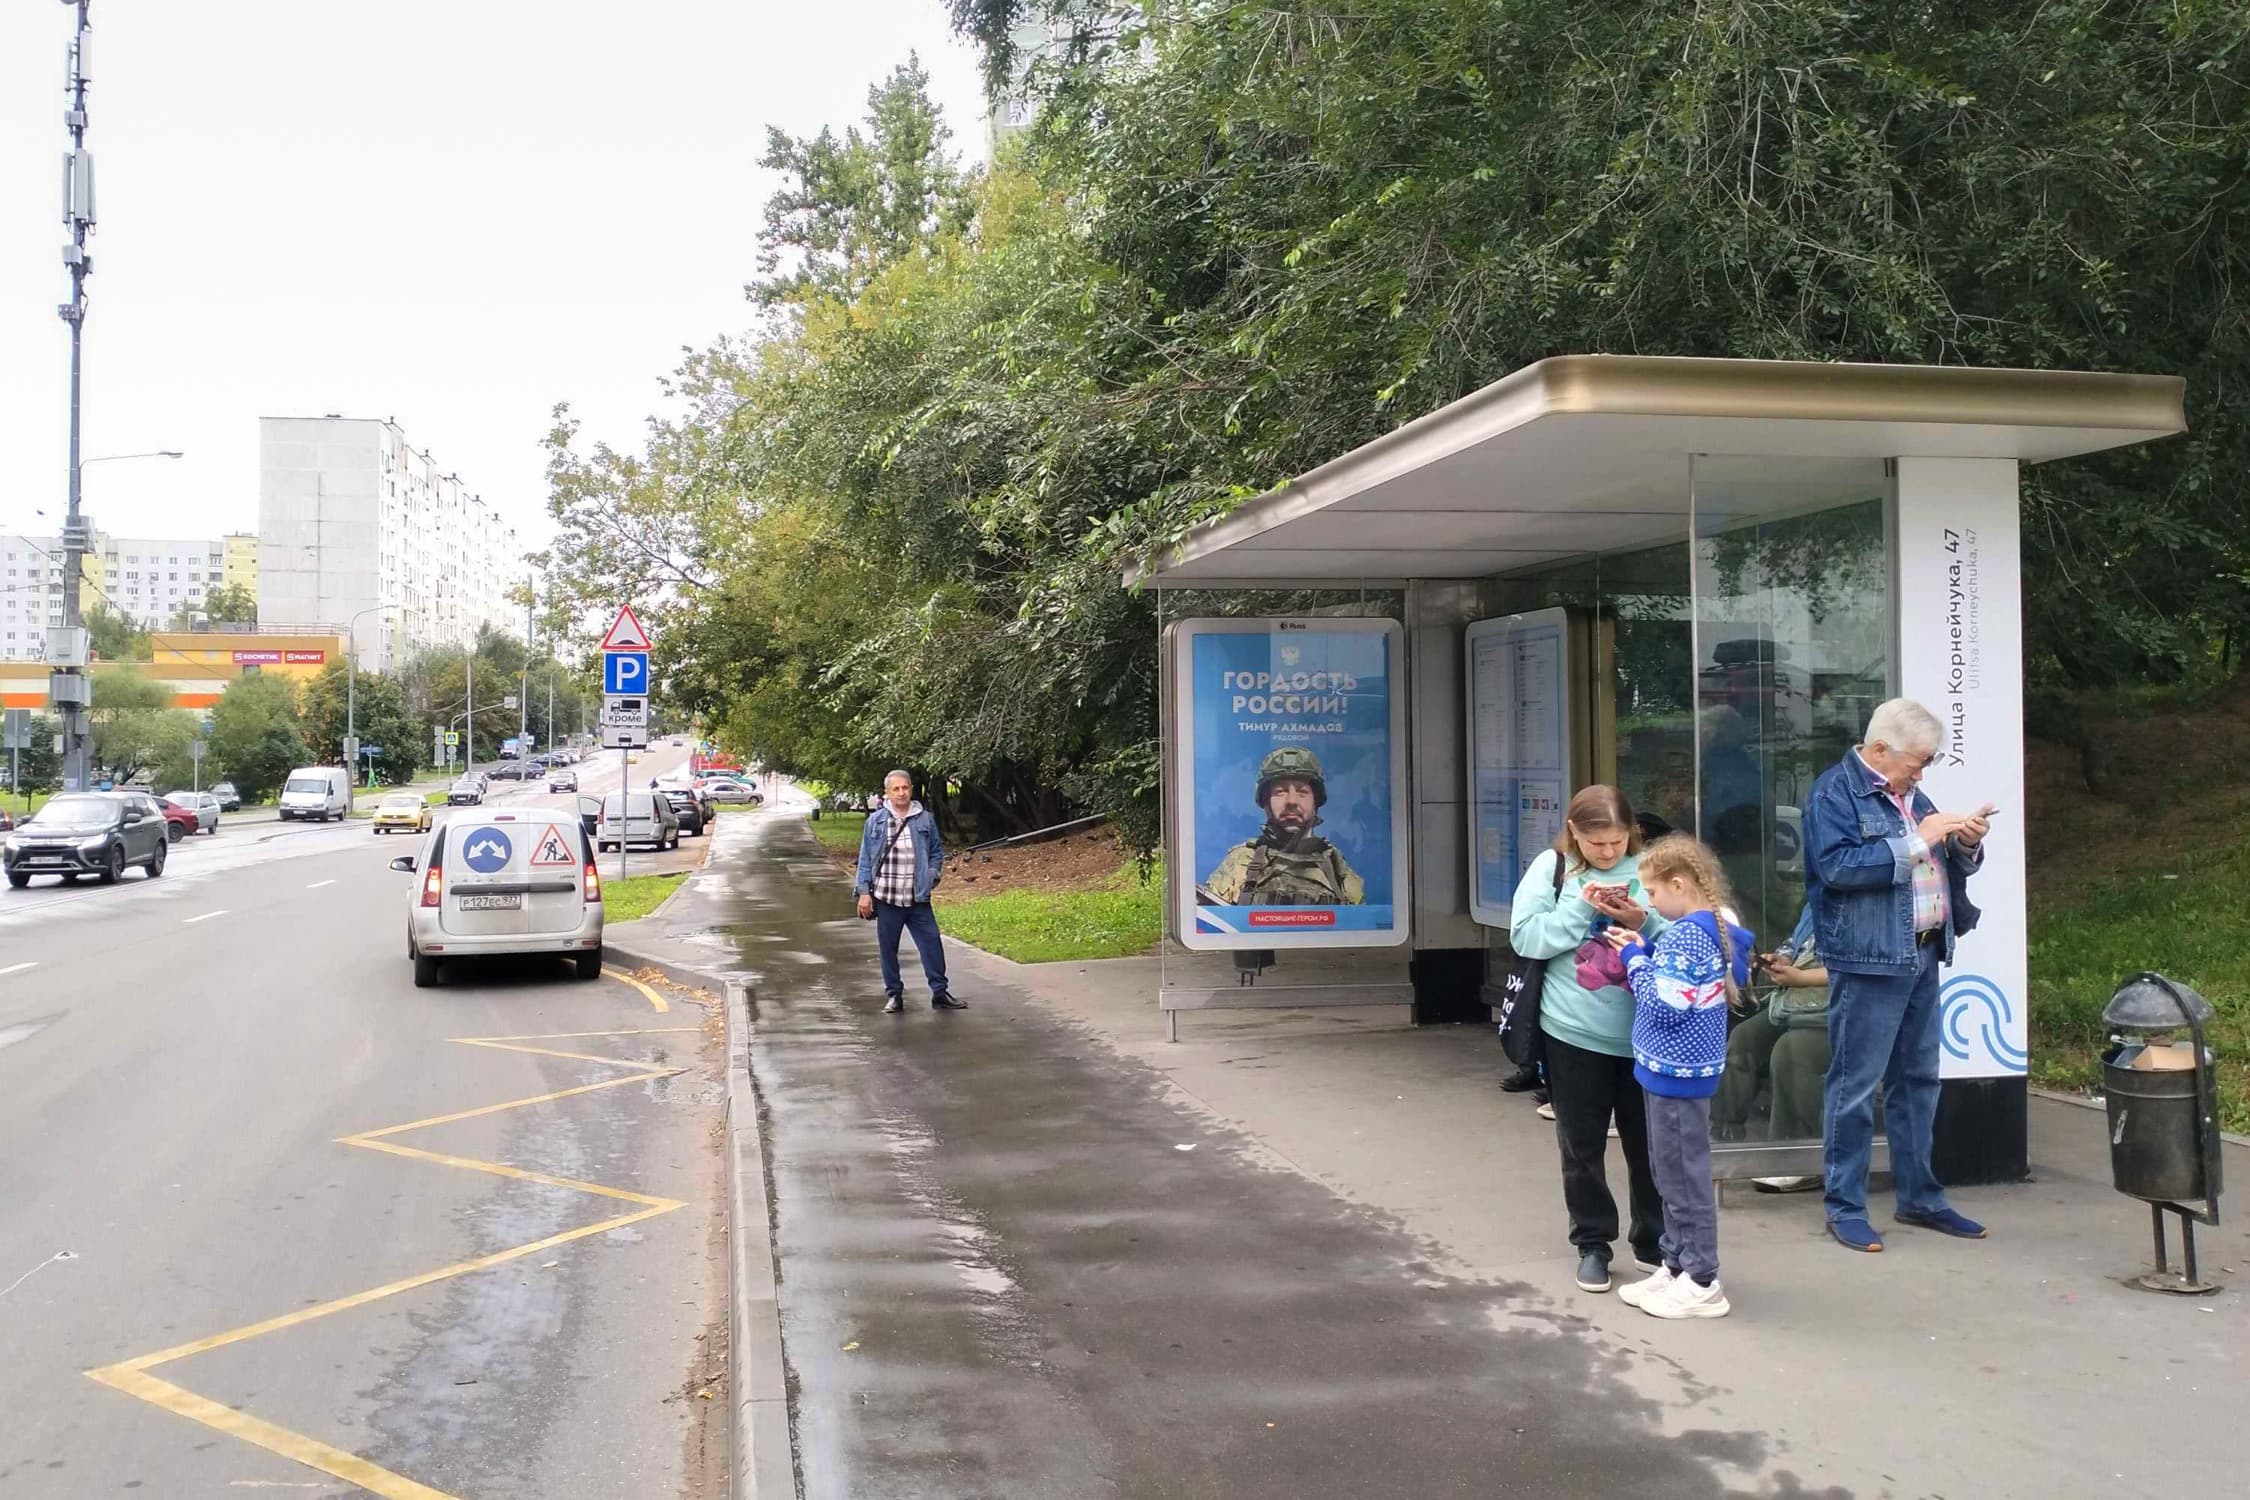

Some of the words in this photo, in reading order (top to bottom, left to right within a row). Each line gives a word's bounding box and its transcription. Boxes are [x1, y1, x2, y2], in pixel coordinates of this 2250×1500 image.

[1944, 528, 1960, 553] 47
[1966, 528, 1977, 545] 47
[1966, 549, 1979, 643] Korneychuka,
[1946, 560, 1966, 694] Корнейчука,
[616, 657, 640, 690] P
[1967, 648, 1980, 689] Ulitsa
[1223, 671, 1358, 693] ГОРДОСТЬ
[1232, 695, 1348, 714] РОССИИ!
[608, 715, 642, 723] кроме
[1238, 722, 1278, 732] ТИМУР
[1281, 723, 1343, 733] АХМАДОВ
[1948, 702, 1966, 767] Улица
